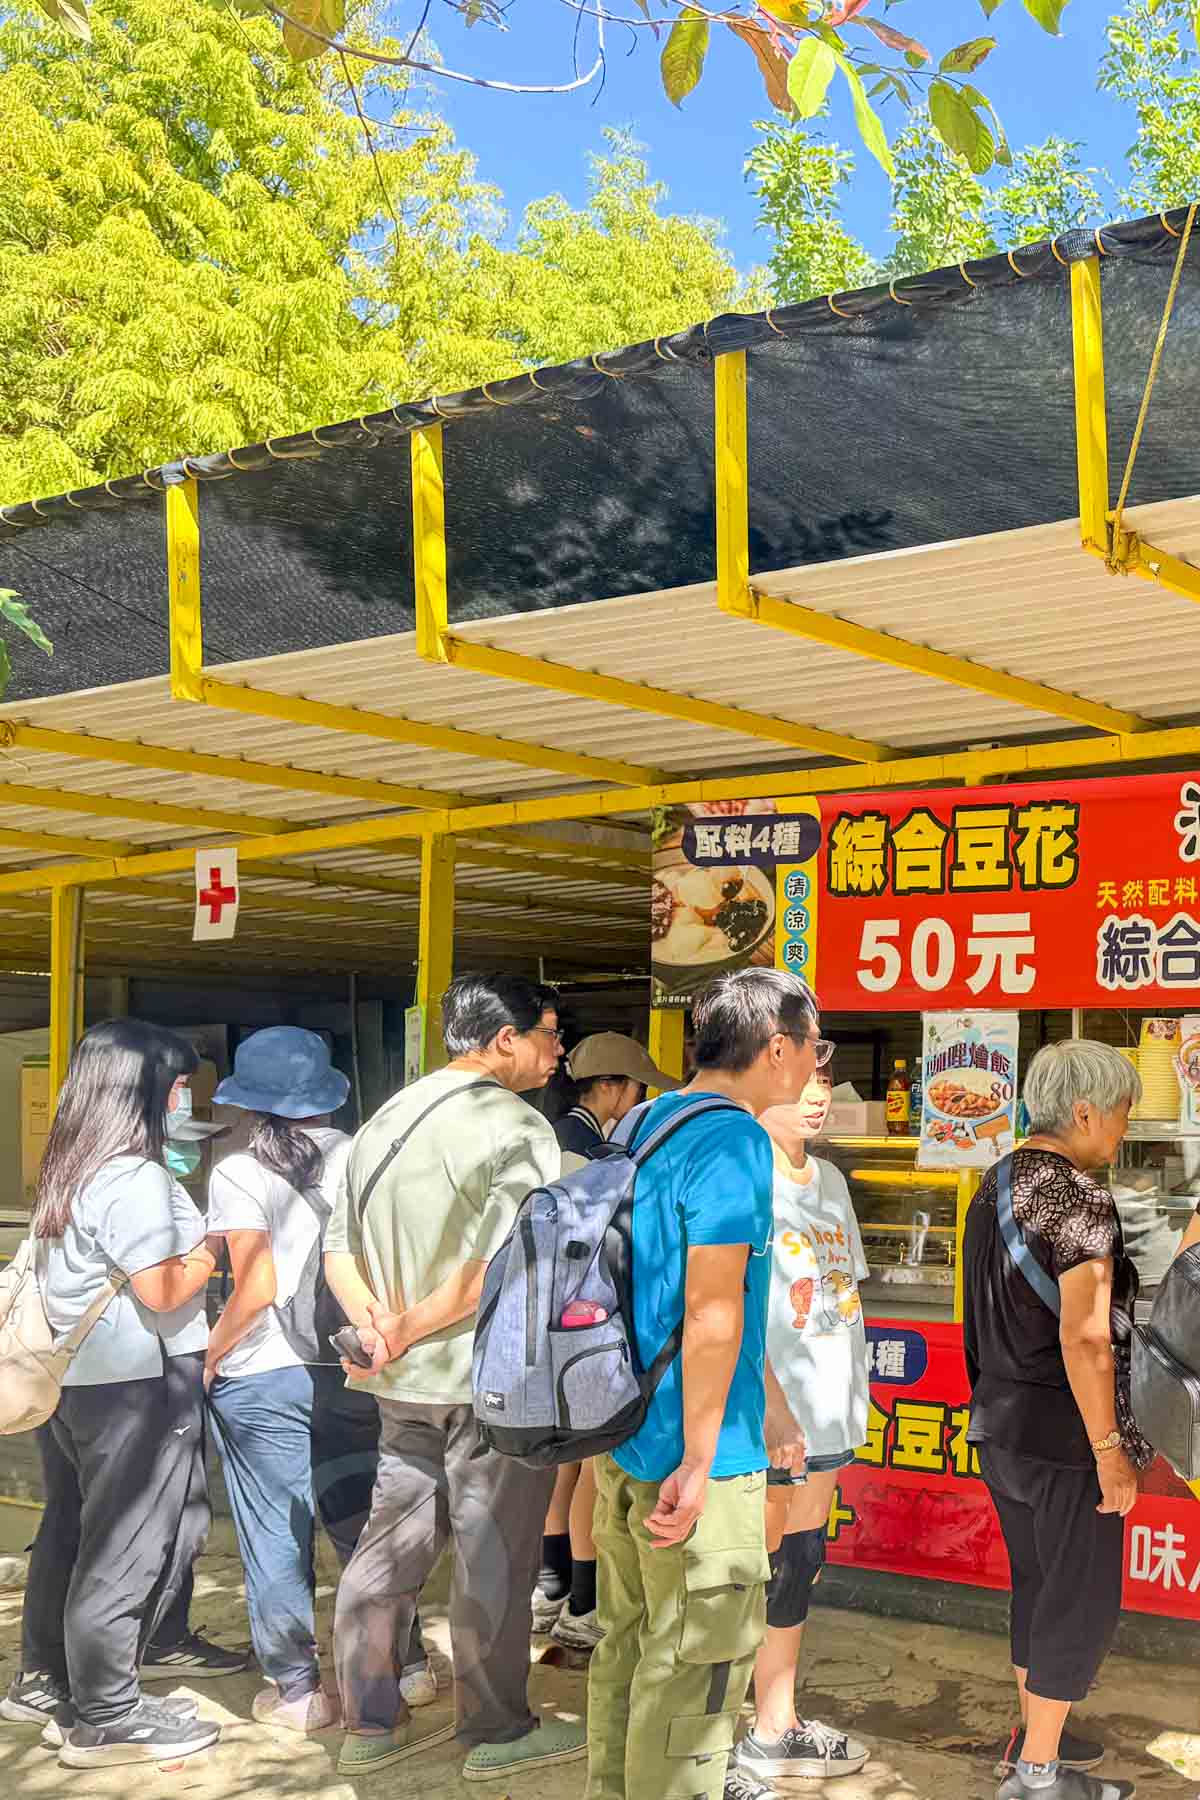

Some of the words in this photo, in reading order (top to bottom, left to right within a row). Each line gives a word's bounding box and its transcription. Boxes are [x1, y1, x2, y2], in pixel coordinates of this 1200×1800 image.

[694, 822, 801, 859] 配料4種
[827, 802, 1080, 896] 綜合豆花
[1097, 877, 1198, 908] 天然配料
[857, 912, 1037, 996] 50元
[926, 1041, 1010, 1080] 咖哩燴飯
[990, 1081, 1014, 1101] 80
